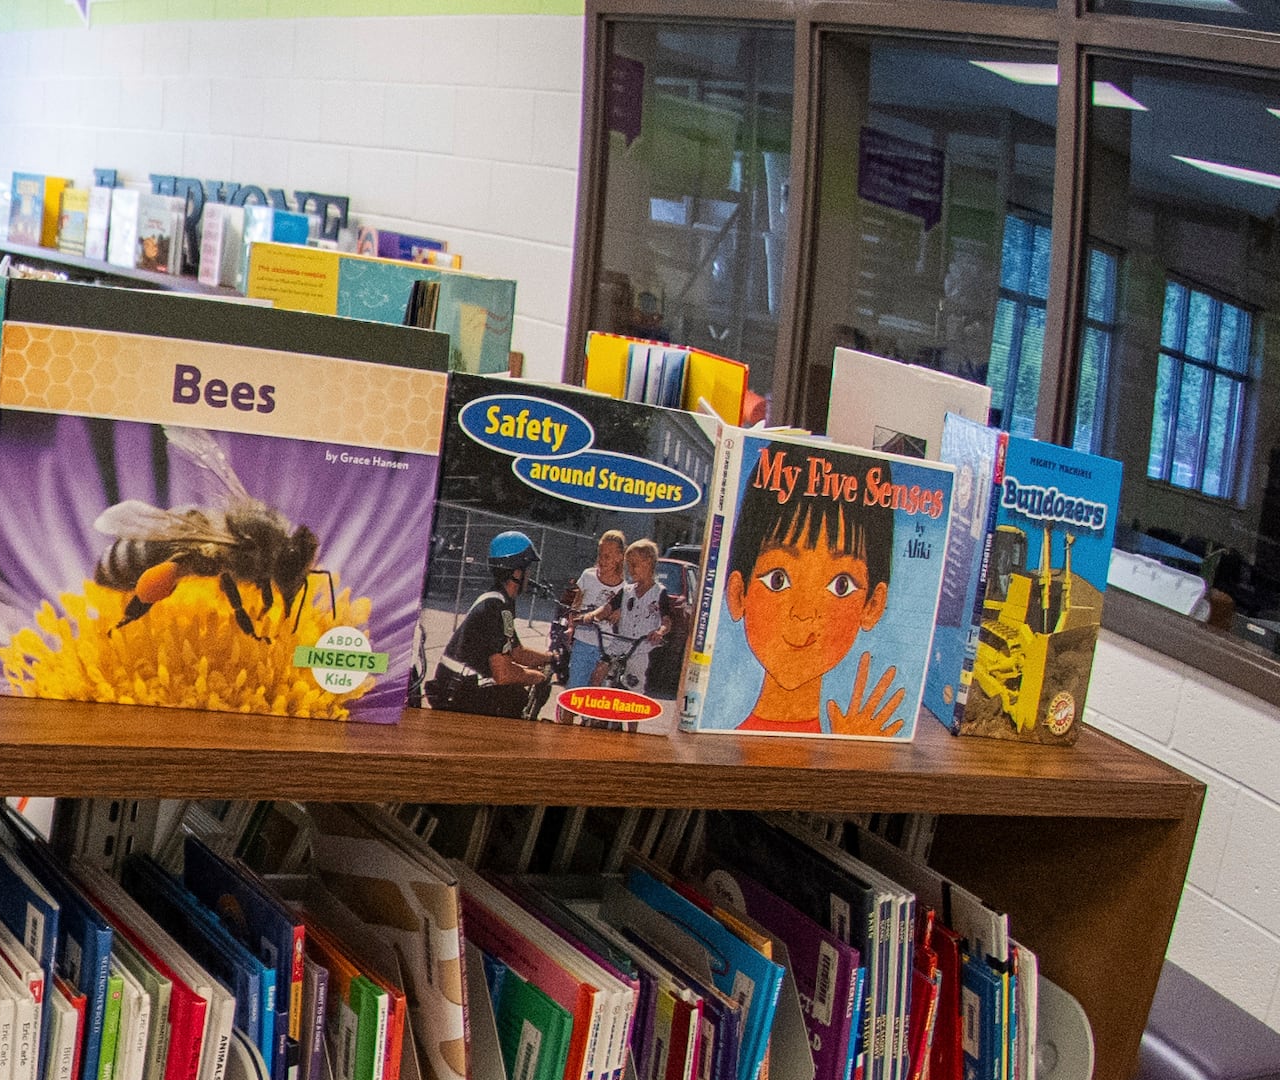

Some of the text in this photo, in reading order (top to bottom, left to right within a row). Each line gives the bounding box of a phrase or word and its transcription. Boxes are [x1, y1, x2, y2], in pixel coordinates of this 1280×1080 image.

[173, 363, 276, 414] Bees
[485, 405, 568, 453] Safety
[325, 450, 409, 470] by Grace Hansen
[1030, 457, 1056, 470] MIGHTY
[529, 462, 683, 503] around Strangers
[753, 448, 801, 505] My
[803, 456, 858, 503] Five
[863, 467, 944, 520] Senses
[1003, 477, 1106, 527] Bulldozers
[915, 522, 926, 537] by
[903, 539, 931, 560] Aliki
[327, 636, 363, 647] ABDO
[308, 651, 376, 669] INSECTS
[325, 673, 352, 687] Kids
[570, 693, 651, 715] by Lucia Raatma
